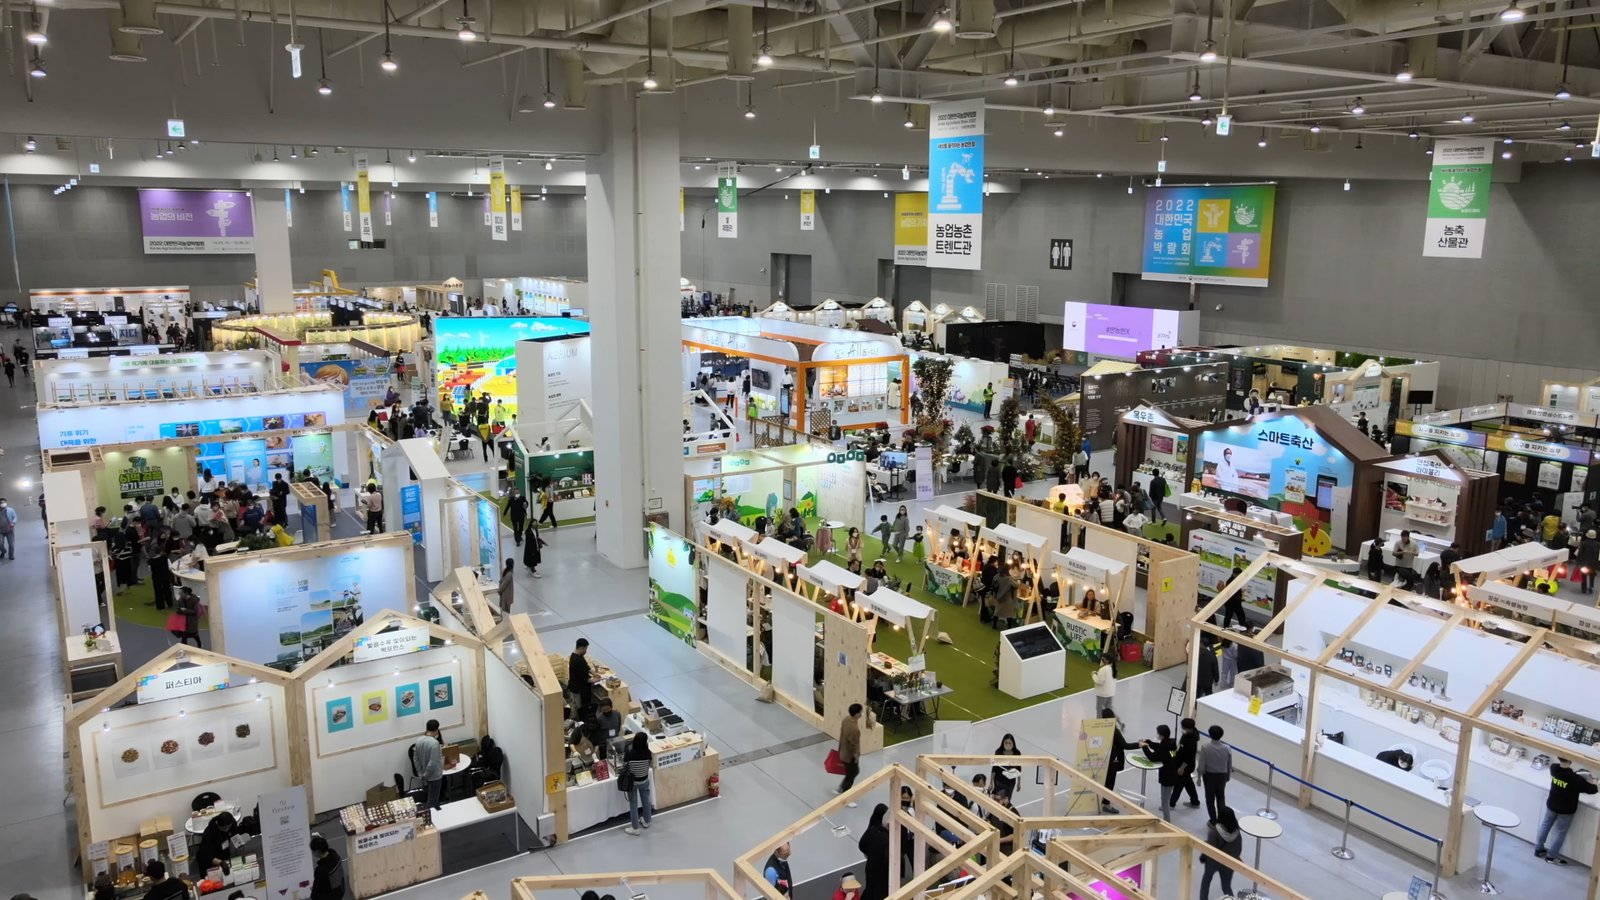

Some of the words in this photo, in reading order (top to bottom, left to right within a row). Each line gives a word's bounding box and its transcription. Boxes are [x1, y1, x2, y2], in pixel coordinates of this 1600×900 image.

[1156, 200, 1193, 211] 2022
[1155, 213, 1192, 226] 대한민국
[936, 224, 972, 238] 농업농촌
[1444, 225, 1464, 236] 농축
[935, 240, 972, 255] 트렌드관
[1438, 237, 1468, 248] 산물관
[1133, 410, 1154, 423] 목우촌
[1257, 429, 1314, 450] 스마트축산
[935, 569, 952, 583] RUSTIC
[938, 578, 948, 588] LIFE
[1066, 621, 1087, 637] RUSTIC
[1070, 632, 1083, 643] LIFE
[165, 676, 202, 690] 퍼스티아
